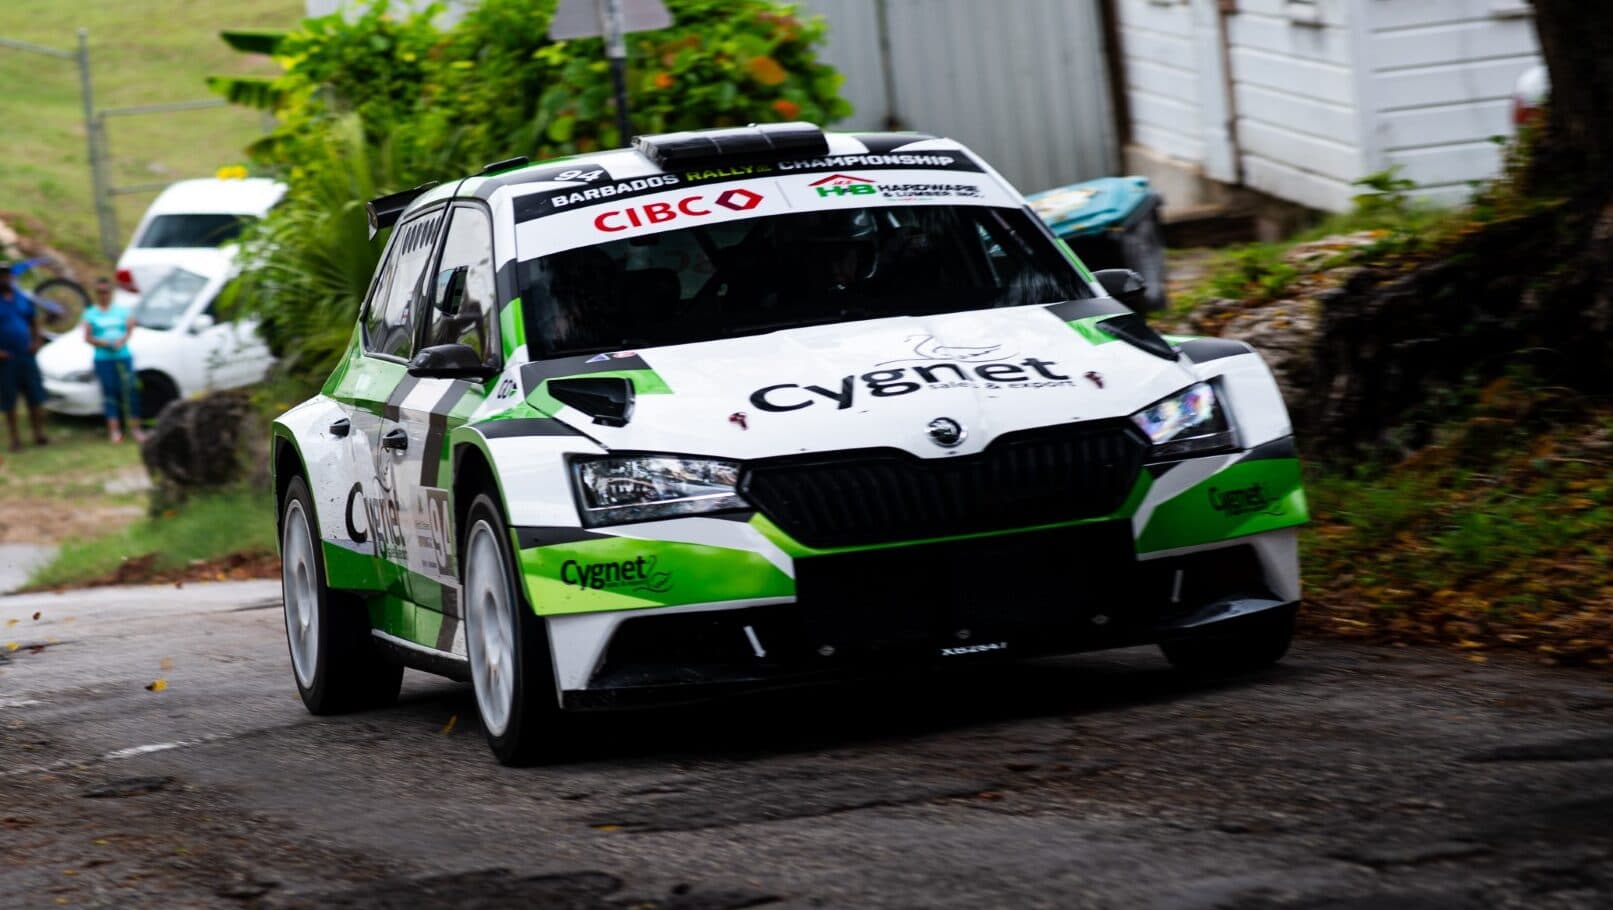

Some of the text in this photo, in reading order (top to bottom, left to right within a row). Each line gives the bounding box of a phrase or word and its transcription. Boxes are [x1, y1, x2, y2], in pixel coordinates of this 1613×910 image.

[551, 174, 680, 208] BARBADOS
[686, 165, 753, 182] RALLY
[778, 154, 956, 171] CHAMPIONSHIP
[553, 169, 605, 181] 94
[594, 196, 712, 232] CIBC
[560, 555, 647, 591] Cygnet
